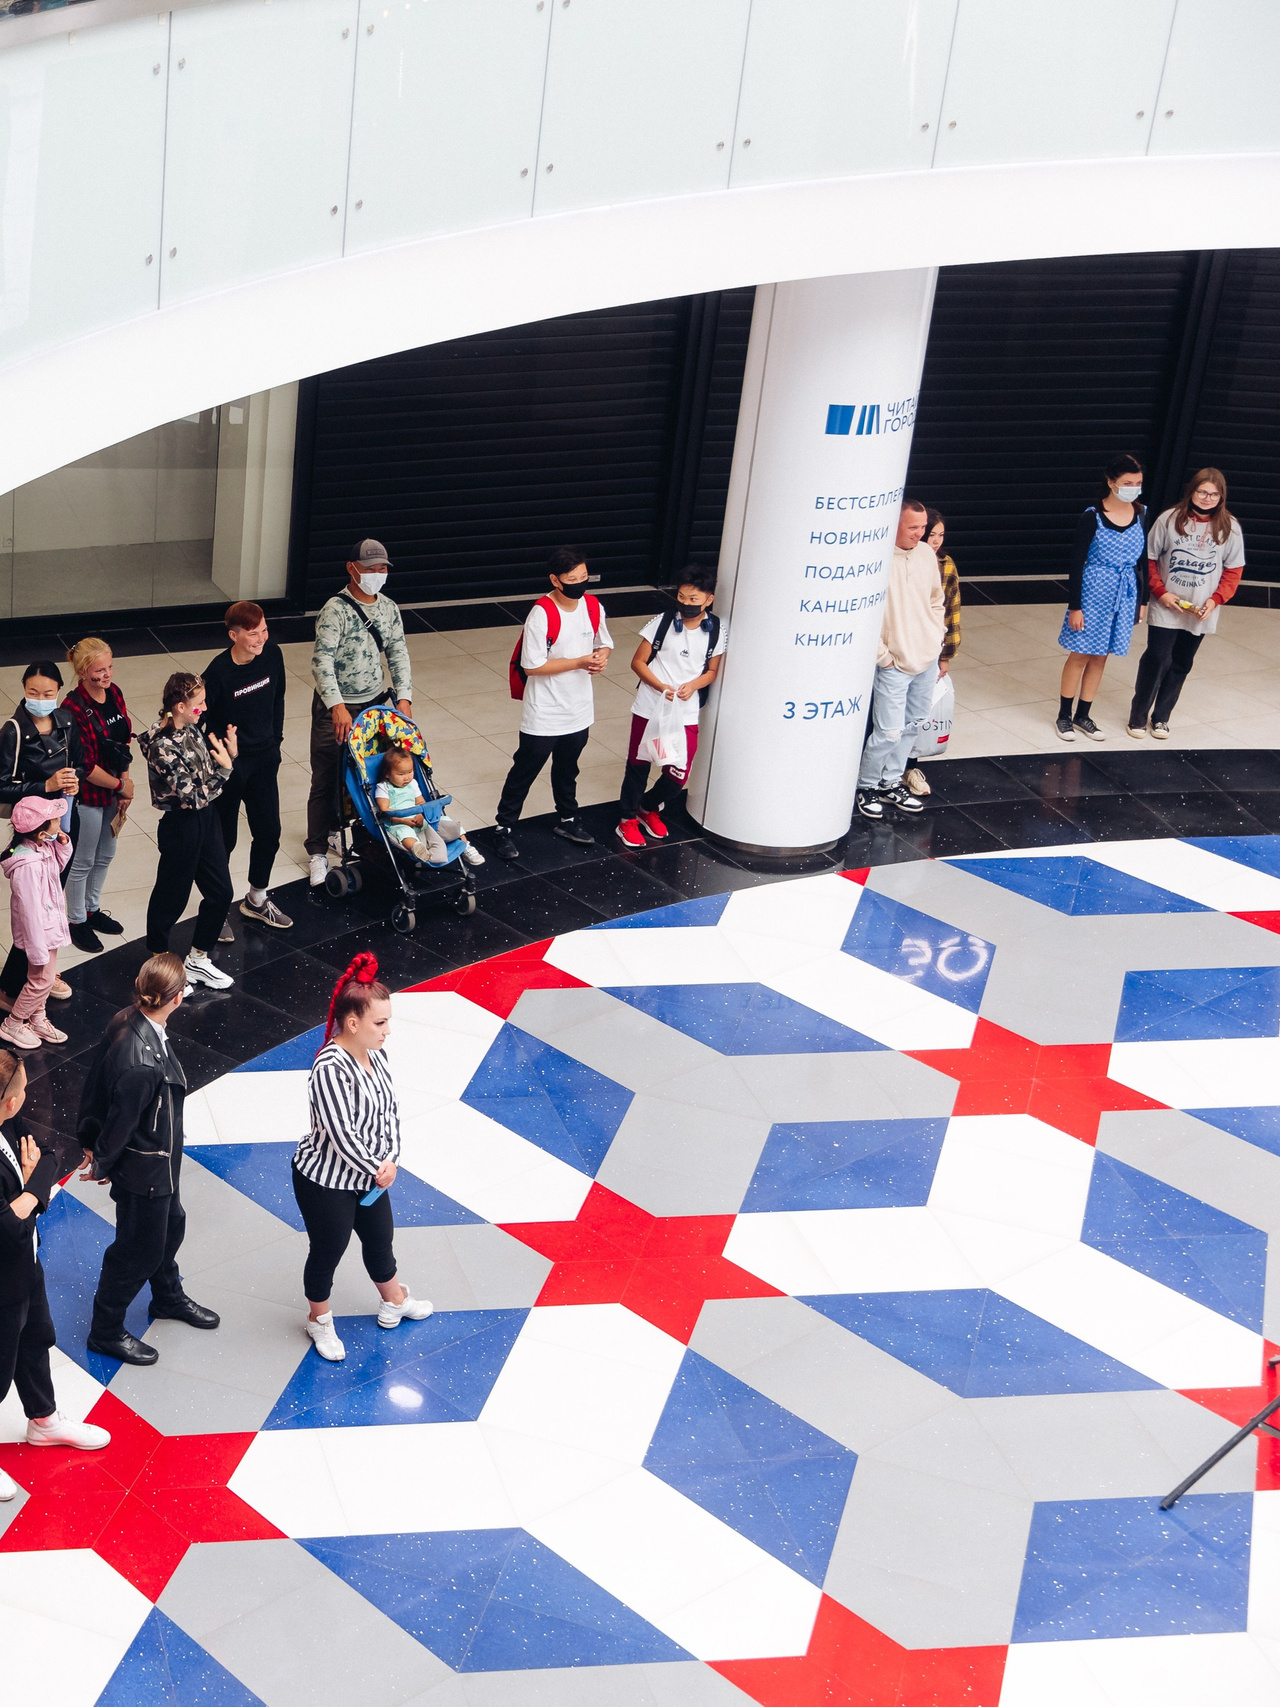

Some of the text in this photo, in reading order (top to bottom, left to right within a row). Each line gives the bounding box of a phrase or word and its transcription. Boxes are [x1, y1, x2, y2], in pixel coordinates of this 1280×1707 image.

[810, 525, 889, 545] НОВИНКИ
[1173, 534, 1194, 546] WEST
[804, 560, 883, 581] ПОДАРКИ
[1169, 556, 1212, 571] Garage
[1170, 575, 1206, 588] ORIGINALS
[794, 632, 853, 646] КНИГИ
[782, 694, 863, 720] 3 ЭТАЖ
